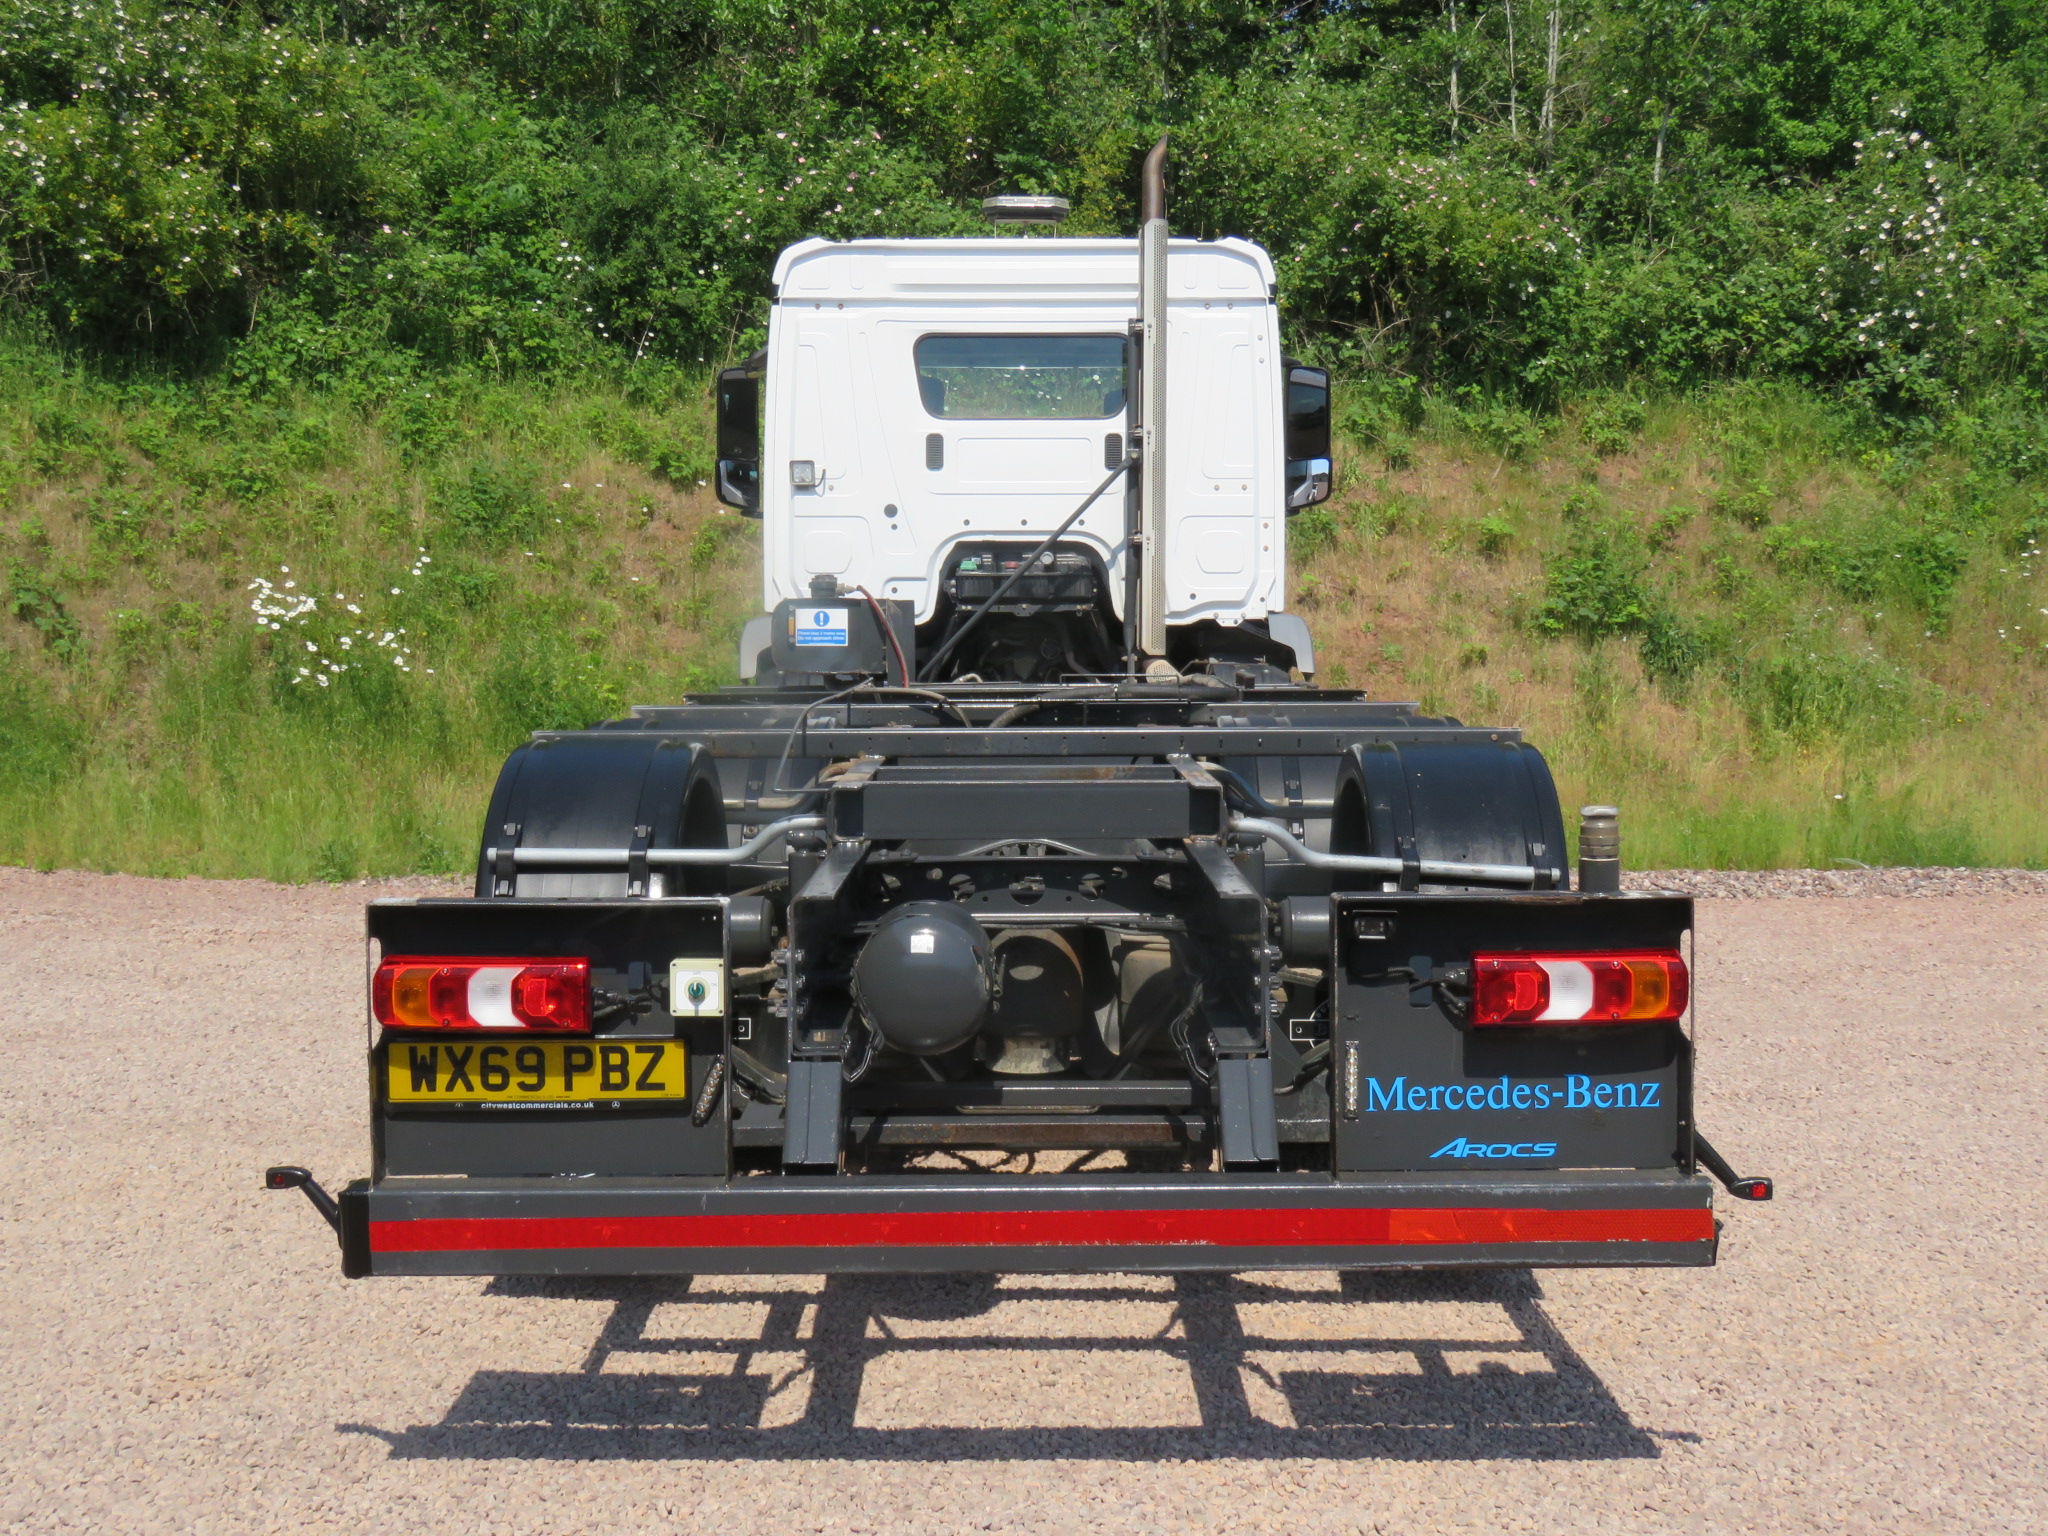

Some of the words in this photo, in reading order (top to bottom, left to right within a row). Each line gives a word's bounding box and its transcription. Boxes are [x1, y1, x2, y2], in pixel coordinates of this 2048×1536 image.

[408, 1045, 546, 1093] WX69
[563, 1044, 666, 1092] PBZ
[1364, 1074, 1661, 1112] Mercedes-Benz
